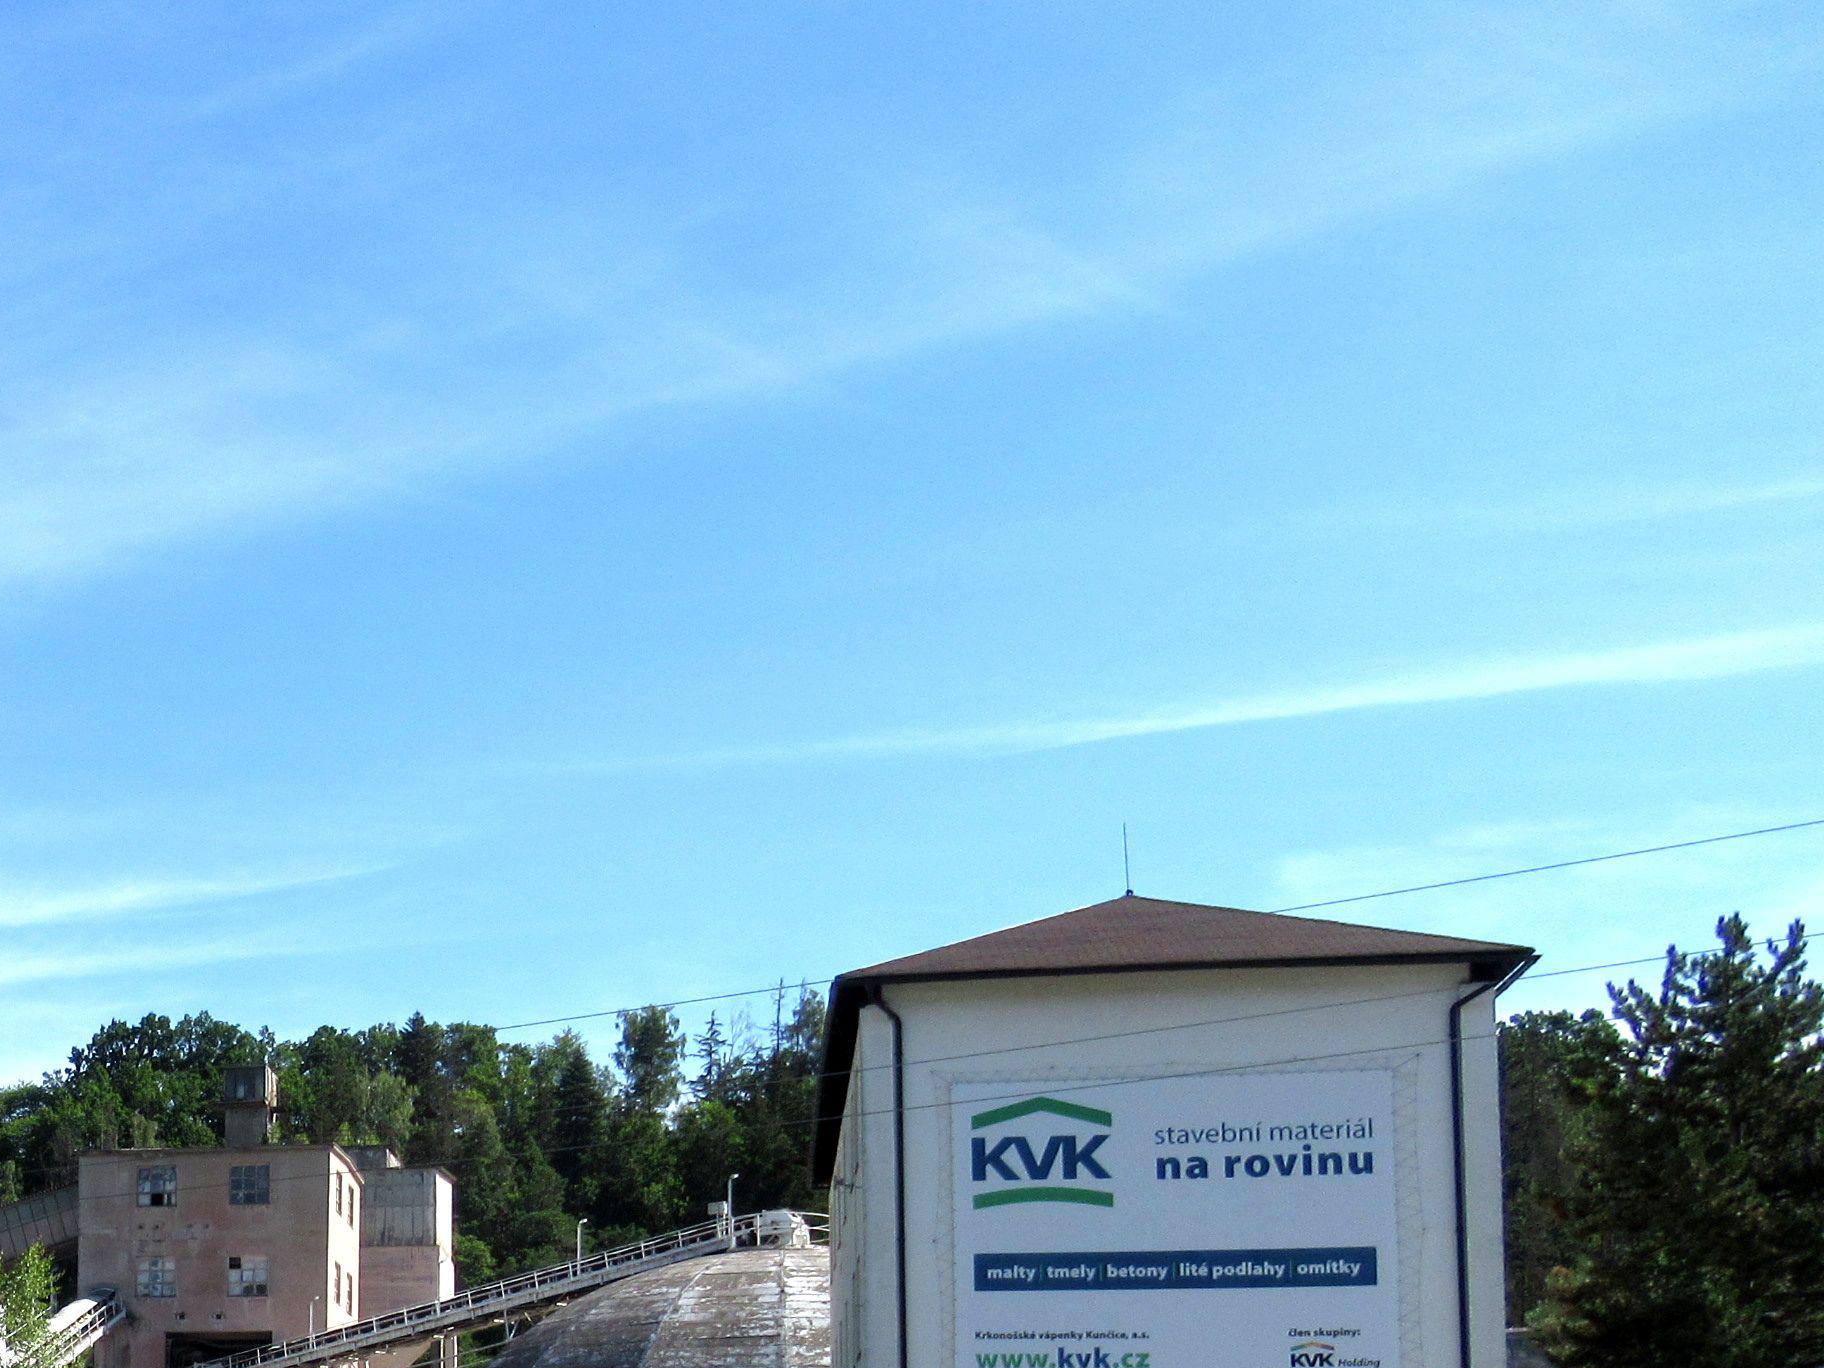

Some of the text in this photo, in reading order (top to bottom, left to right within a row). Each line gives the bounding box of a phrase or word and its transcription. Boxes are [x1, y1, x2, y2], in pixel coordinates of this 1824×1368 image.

[1154, 1118, 1374, 1145] stavební materiál
[971, 1134, 1112, 1181] KVK
[1156, 1144, 1374, 1180] na rovinu
[987, 1258, 1361, 1281] malty tmely betony lité podlahy omítky
[1038, 1330, 1083, 1341] vápenky
[1131, 1331, 1150, 1340] a.s.
[1313, 1327, 1361, 1338] skupiny:
[975, 1347, 1151, 1368] www.kvk.cz
[1290, 1353, 1381, 1368] KVK Holding
